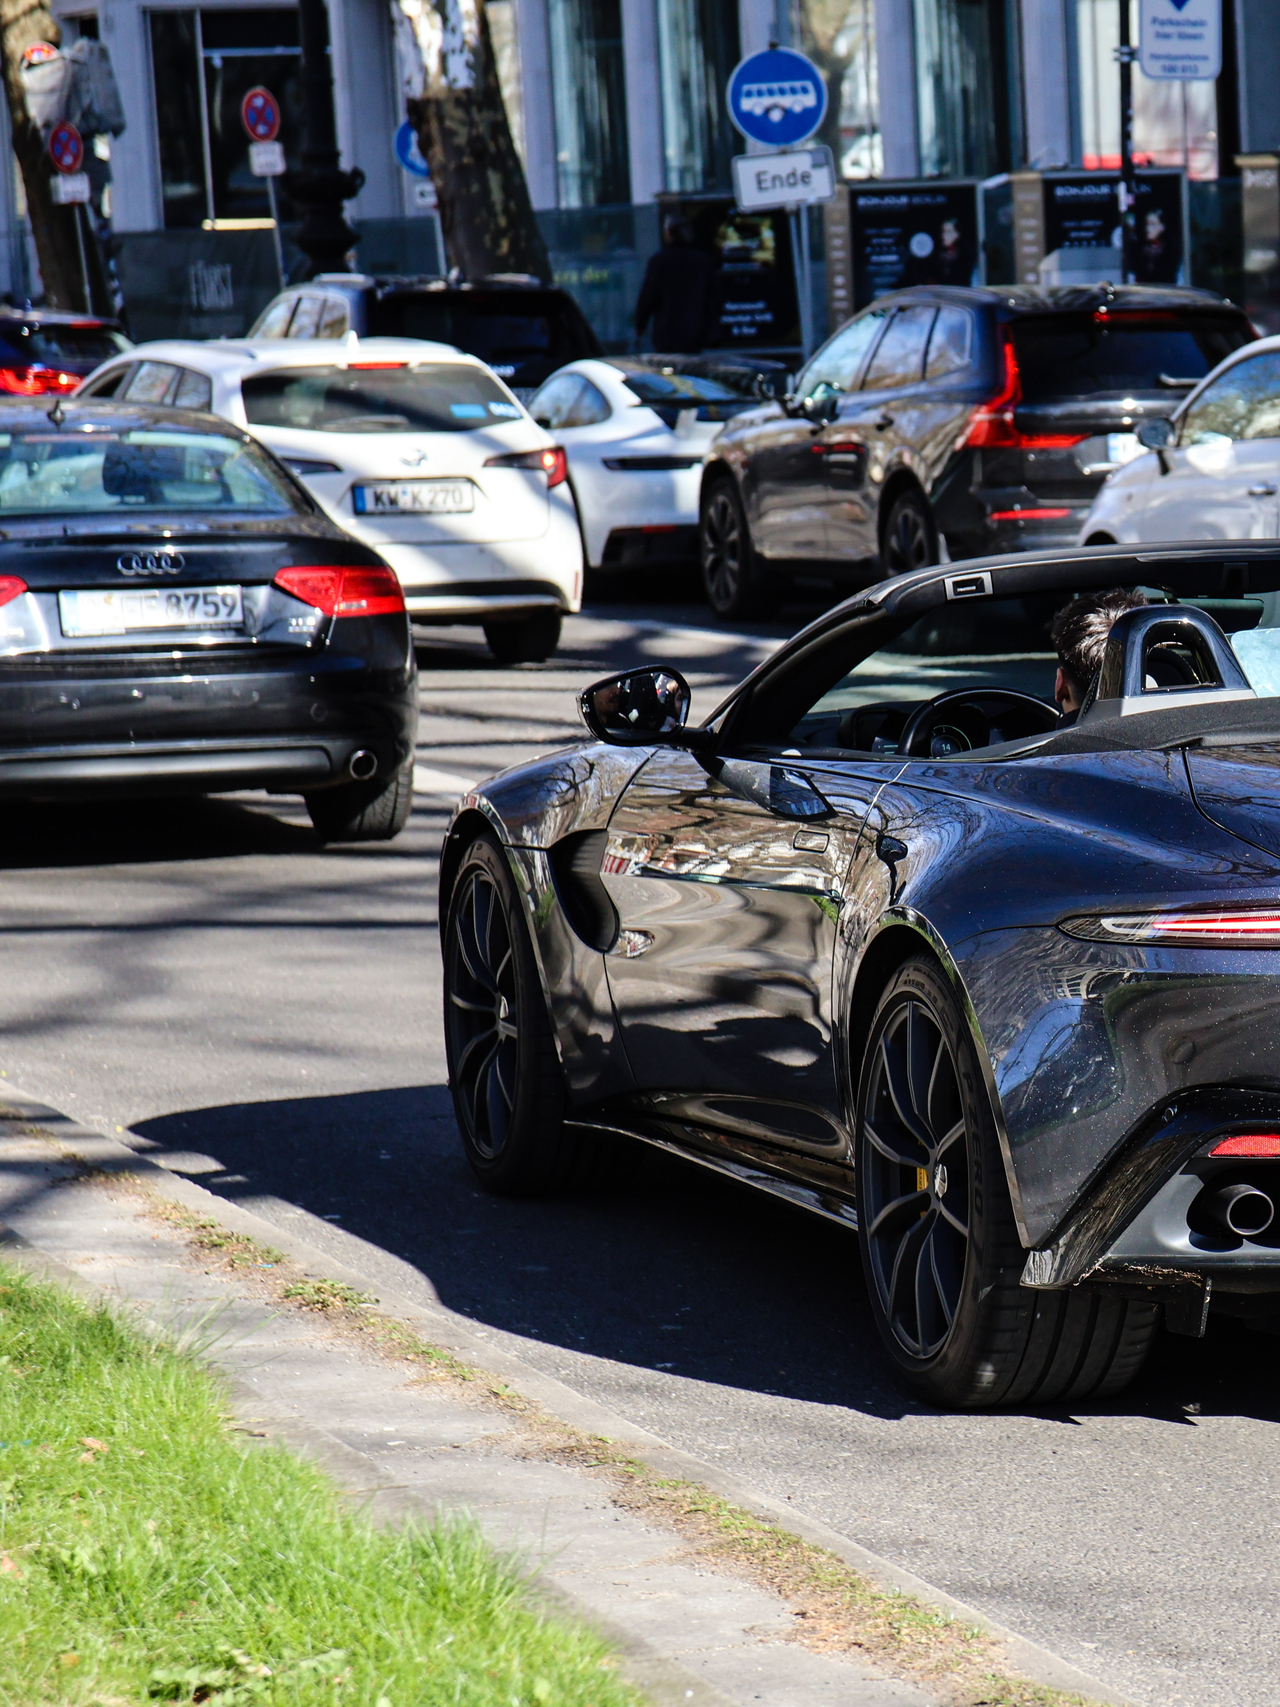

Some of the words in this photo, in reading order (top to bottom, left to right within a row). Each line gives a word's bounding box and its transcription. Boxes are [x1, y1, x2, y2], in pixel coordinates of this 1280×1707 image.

[755, 167, 812, 191] Ende
[857, 195, 909, 206] BONJOUR
[411, 488, 424, 506] K
[427, 487, 463, 505] 270
[165, 592, 238, 618] 8759
